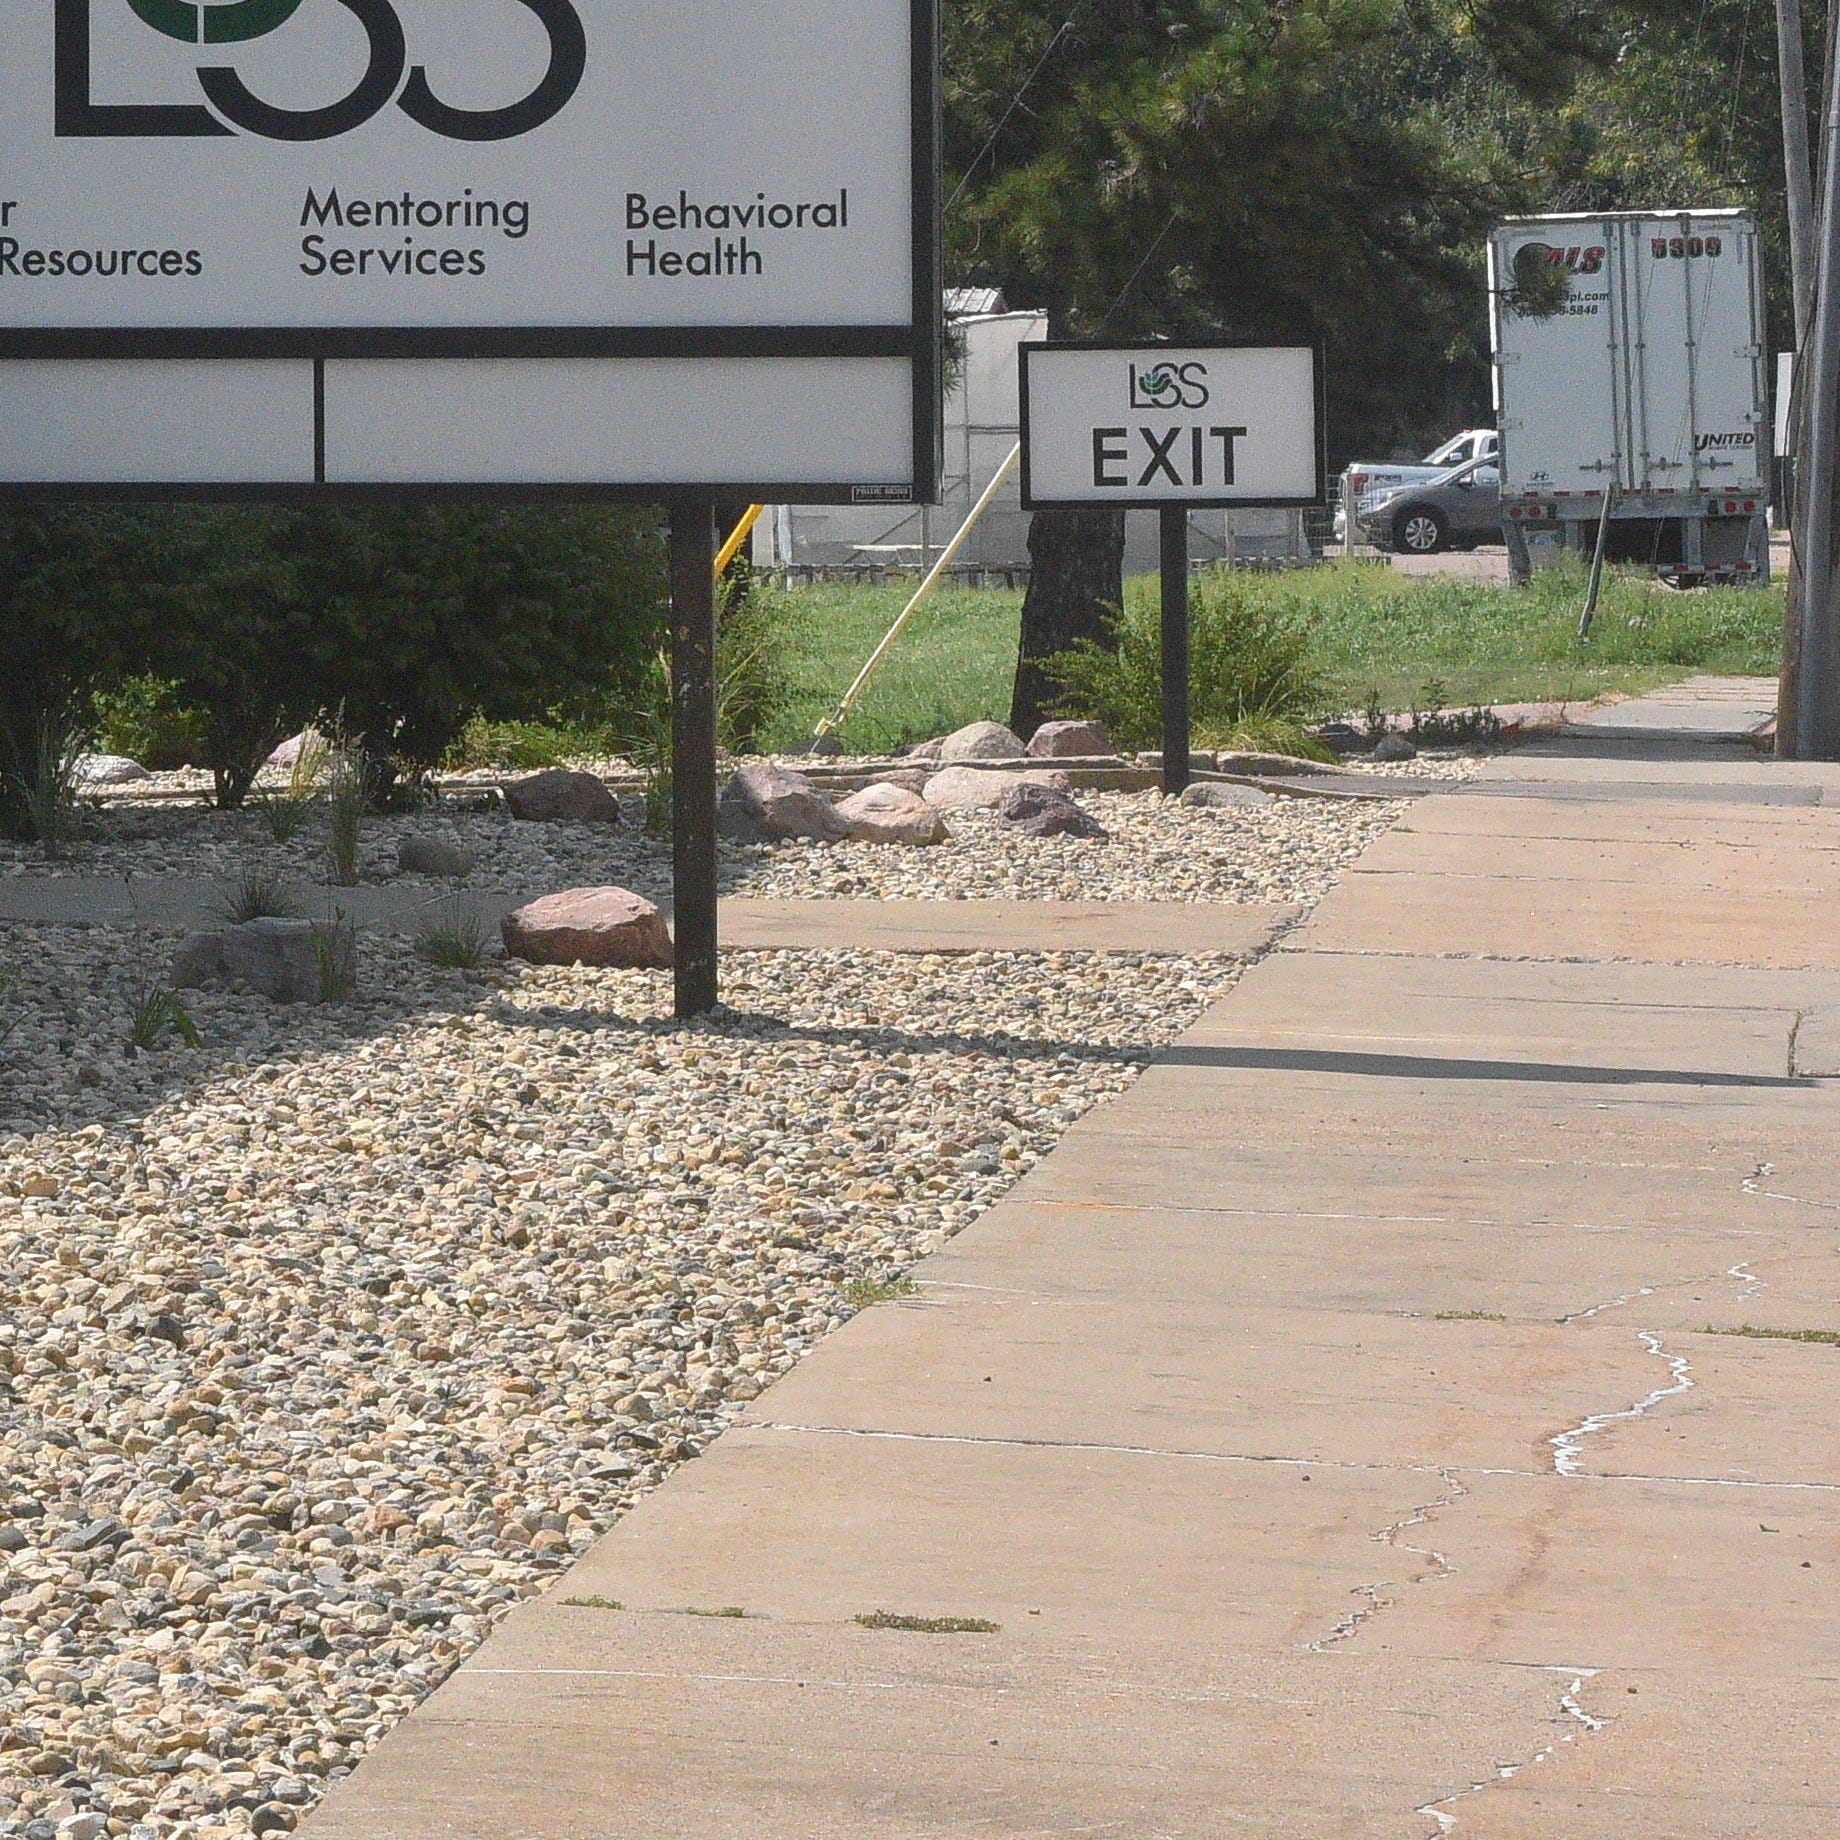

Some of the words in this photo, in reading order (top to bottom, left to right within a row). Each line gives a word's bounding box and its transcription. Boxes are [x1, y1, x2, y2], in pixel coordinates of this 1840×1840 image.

[299, 187, 529, 239] Mentoring
[626, 187, 848, 230] Behavioral
[299, 236, 486, 277] Services
[626, 235, 763, 277] Health
[1128, 361, 1210, 410] LSS
[1092, 426, 1248, 487] EXIT
[1694, 432, 1755, 450] UNITED
